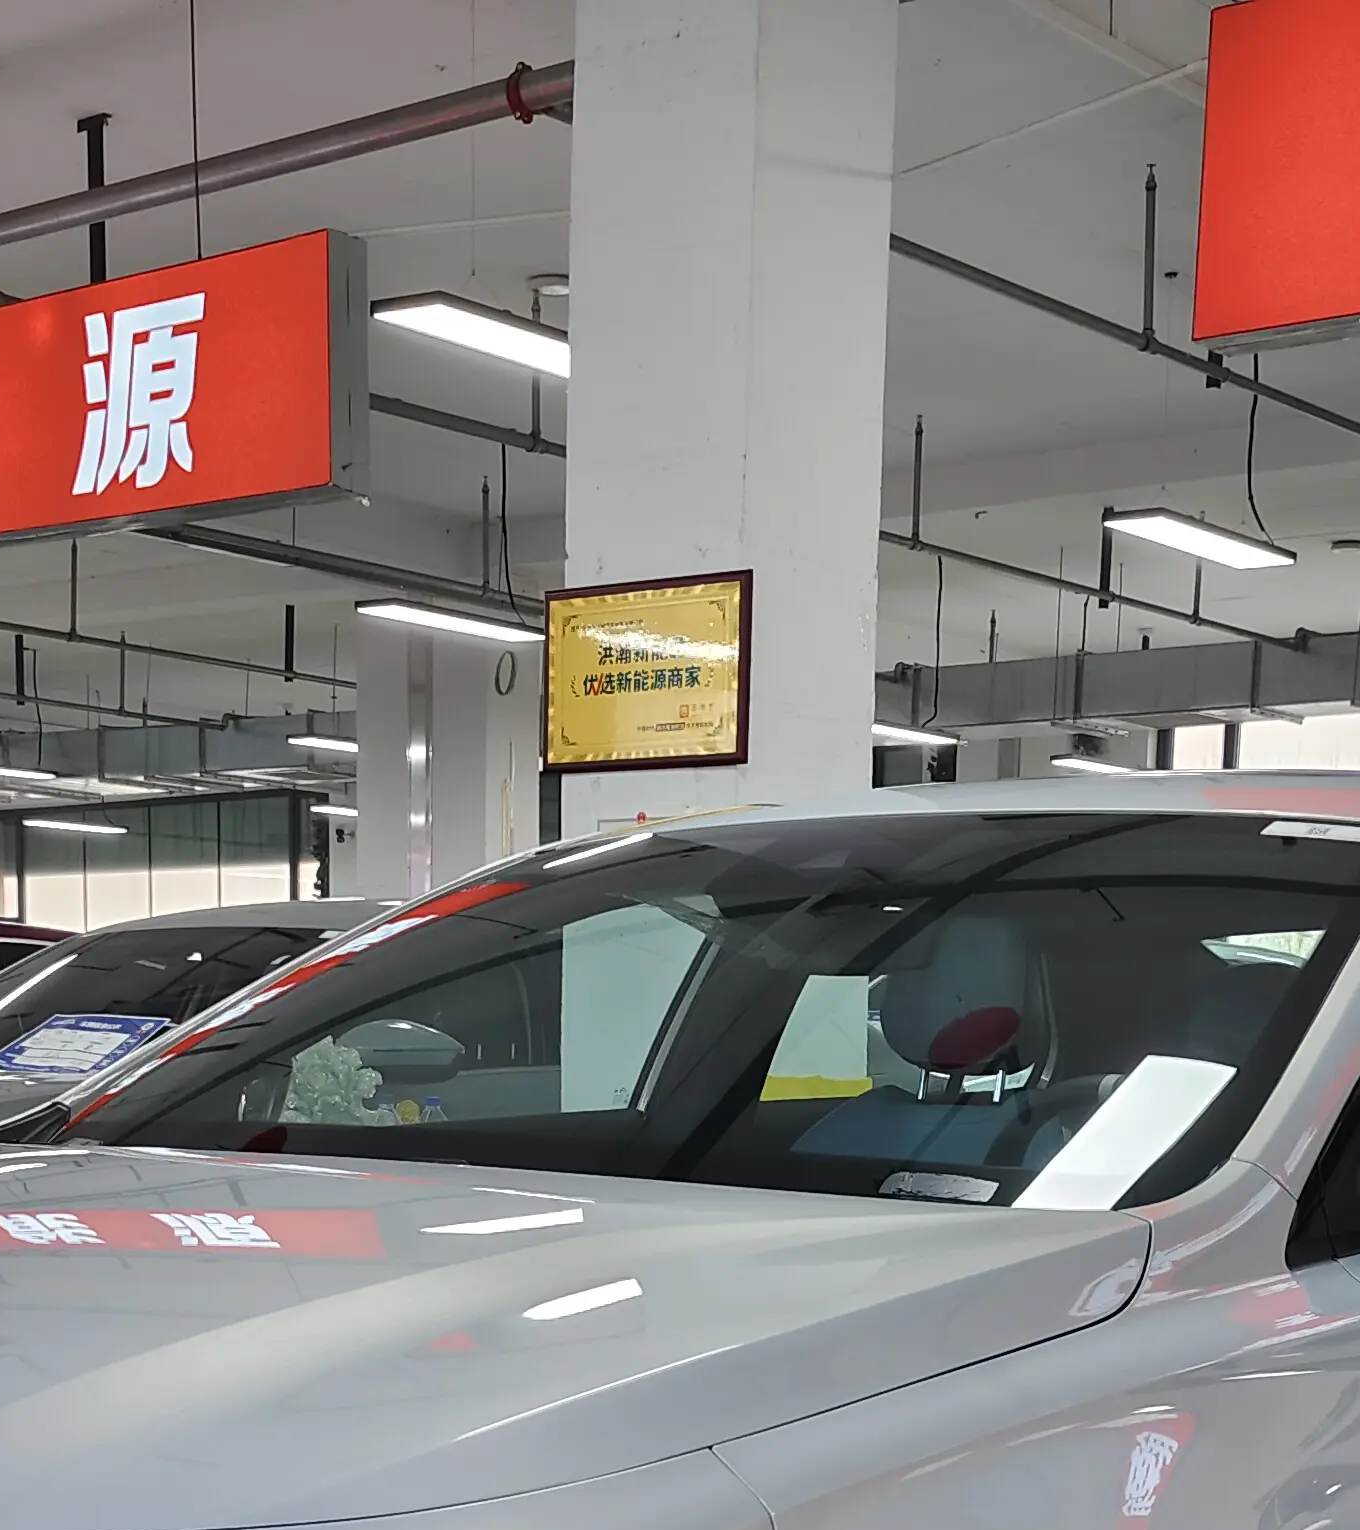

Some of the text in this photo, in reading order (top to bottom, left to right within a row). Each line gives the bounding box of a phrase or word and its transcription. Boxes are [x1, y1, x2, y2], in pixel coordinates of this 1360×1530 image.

[583, 665, 702, 697] 优选新能源商家
